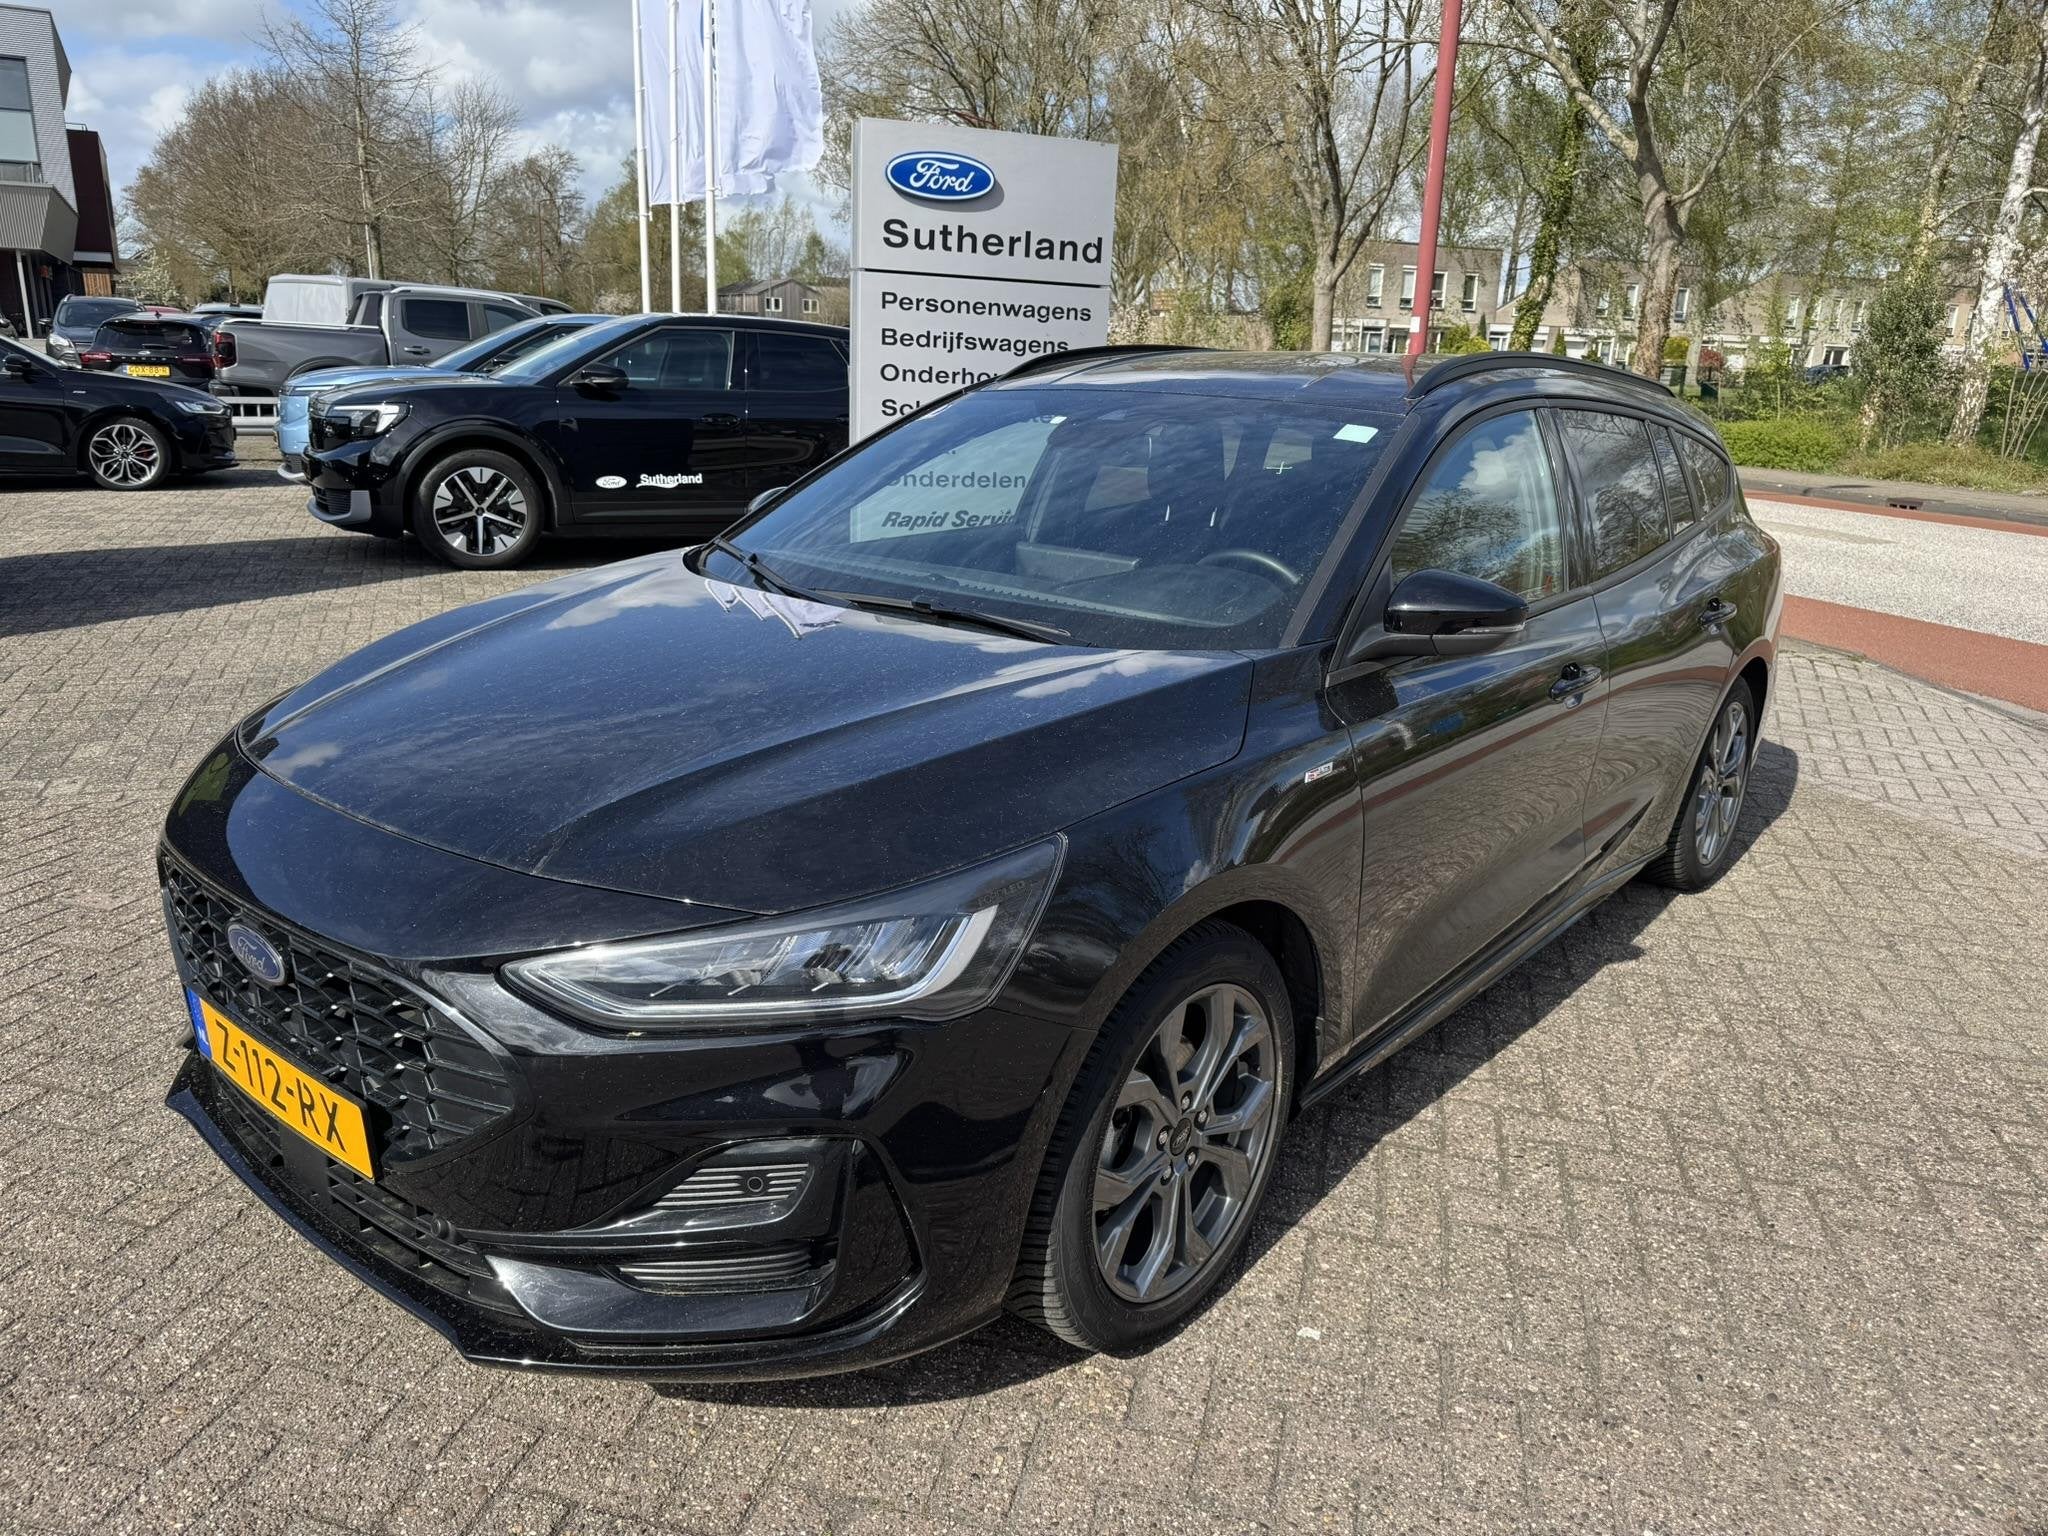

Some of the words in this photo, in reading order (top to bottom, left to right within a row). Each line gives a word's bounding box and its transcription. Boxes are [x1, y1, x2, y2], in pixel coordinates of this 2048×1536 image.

[908, 158, 975, 194] Ford
[882, 218, 1103, 264] Sutherland
[880, 291, 1092, 323] Personenwagens
[880, 327, 1069, 357] Bedrijfswagens
[879, 363, 998, 385] Onderho
[639, 472, 704, 485] Sutherland
[881, 509, 950, 531] Rapid
[215, 1018, 348, 1153] Z-112-RX
